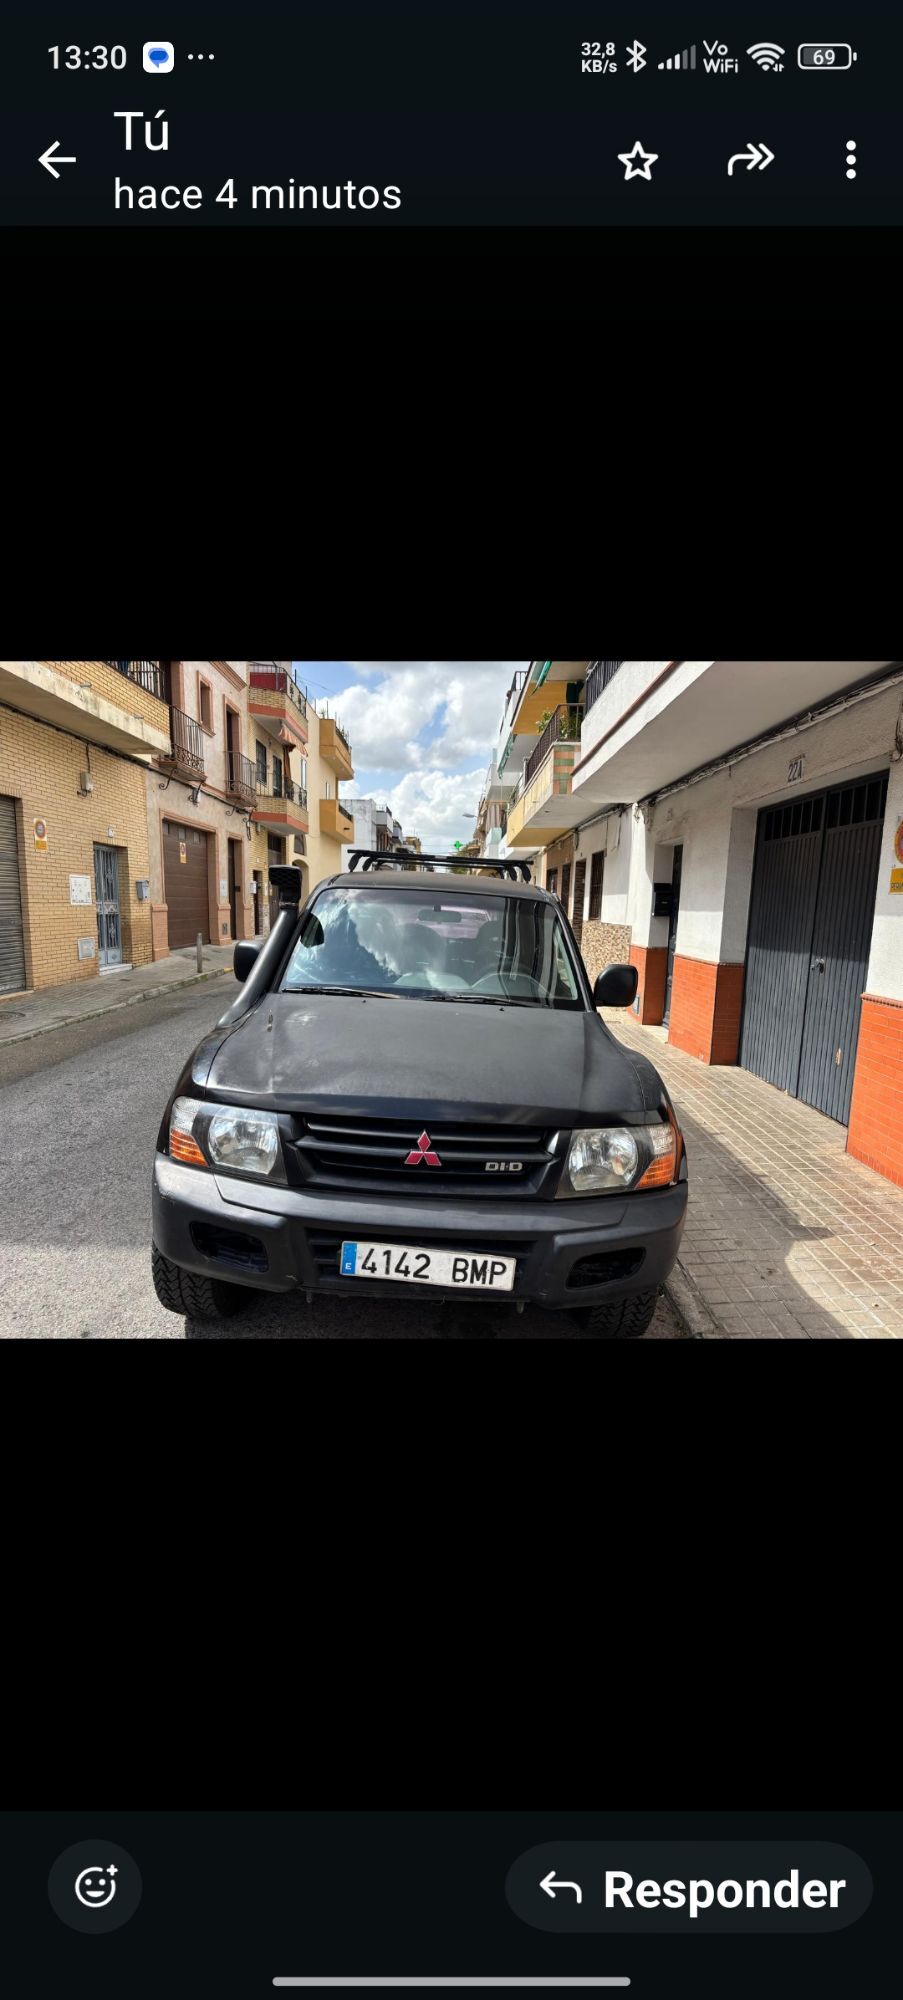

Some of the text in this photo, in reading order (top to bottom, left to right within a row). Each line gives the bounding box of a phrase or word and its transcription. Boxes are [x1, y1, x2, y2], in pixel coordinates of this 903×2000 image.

[345, 1248, 507, 1286] E 4142 BMP
